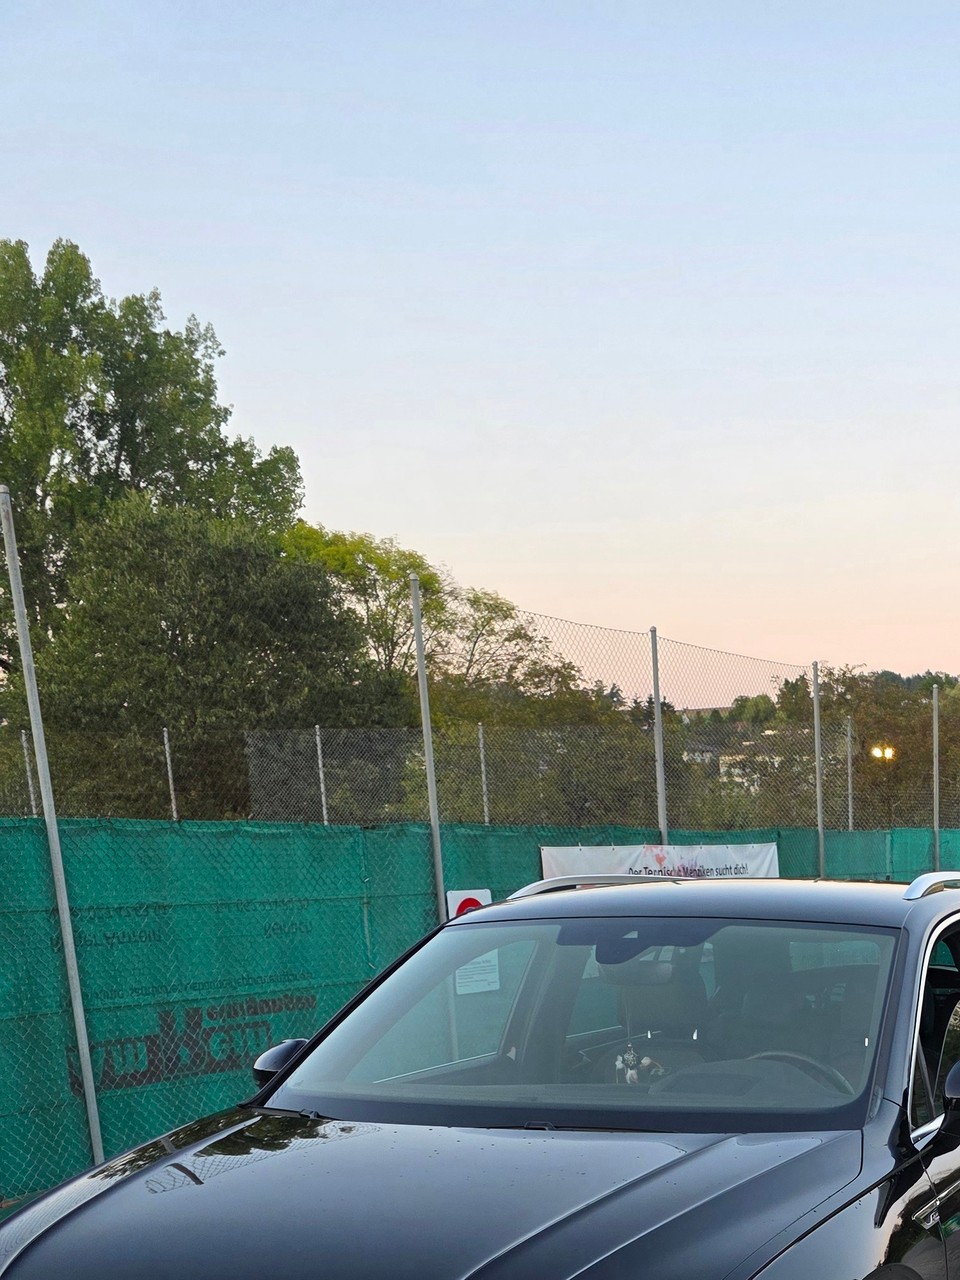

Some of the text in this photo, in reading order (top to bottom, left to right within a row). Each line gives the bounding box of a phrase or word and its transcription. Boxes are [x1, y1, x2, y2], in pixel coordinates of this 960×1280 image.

[682, 866, 715, 878] Menziken
[716, 864, 733, 876] sucht
[734, 863, 749, 876] dich!
